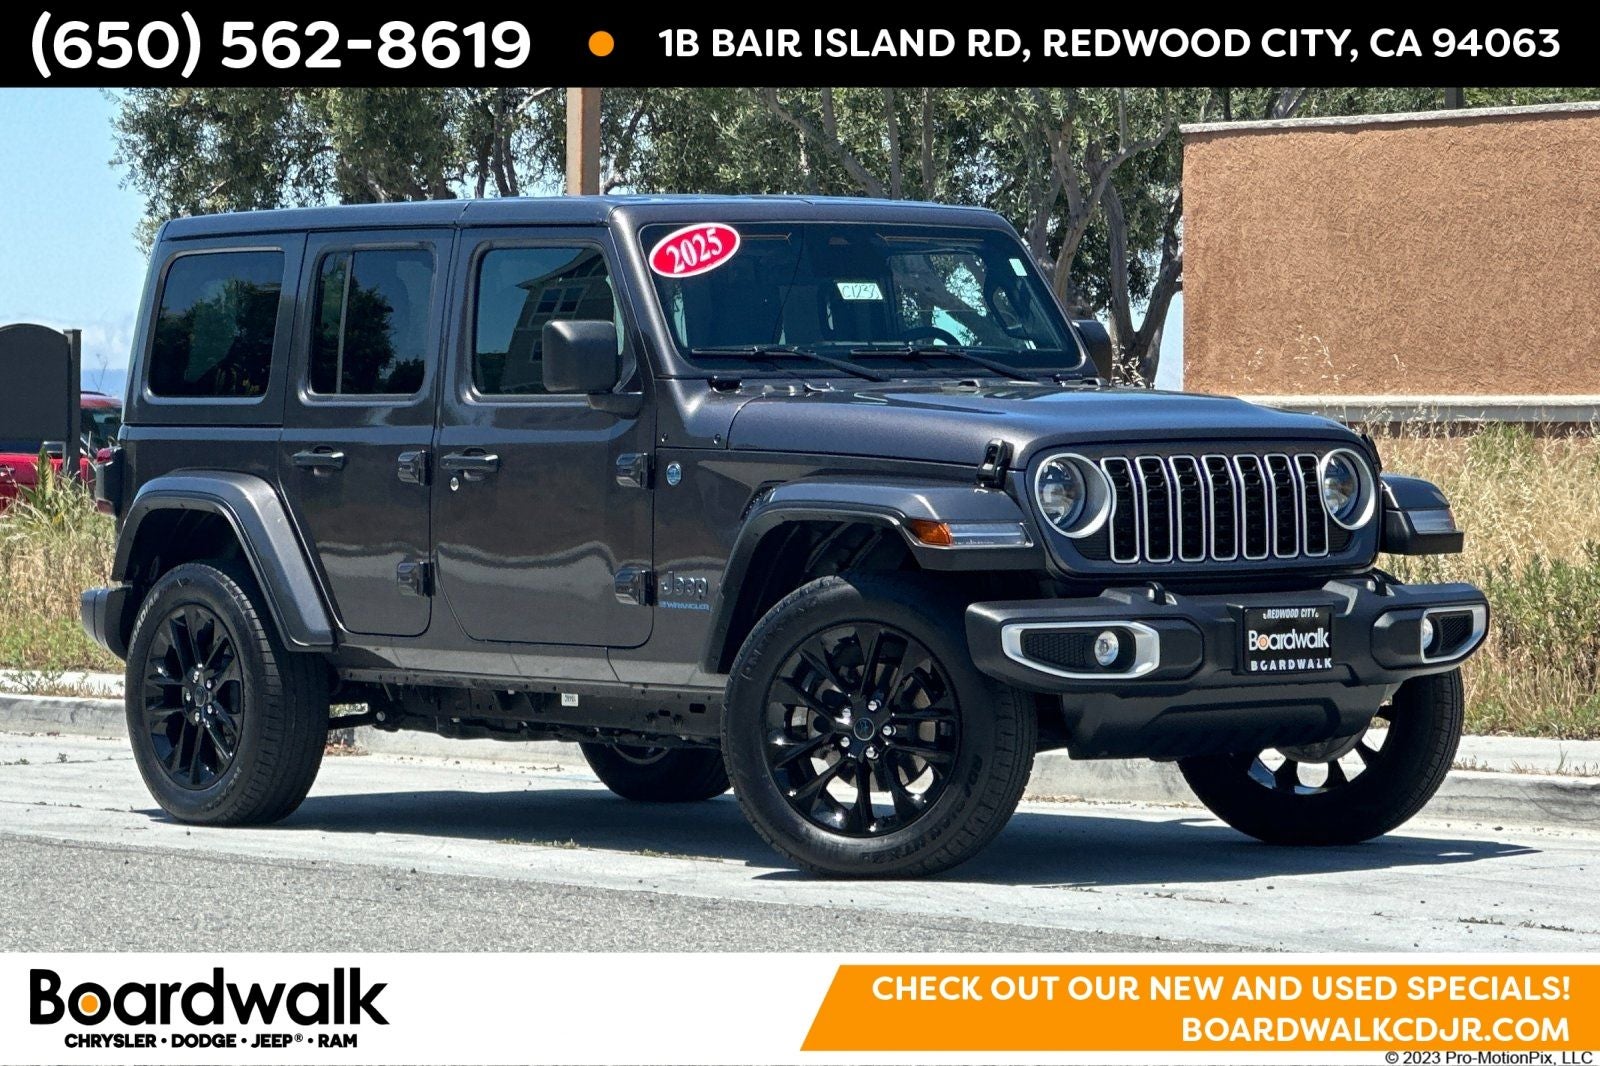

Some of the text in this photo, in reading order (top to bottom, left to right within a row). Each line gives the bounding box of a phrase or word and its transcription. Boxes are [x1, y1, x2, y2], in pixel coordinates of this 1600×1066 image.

[665, 228, 723, 274] 2025
[660, 570, 708, 600] Jeep
[1267, 607, 1316, 619] REDWOOD CITY
[1248, 627, 1330, 651] Boardwalk
[1250, 657, 1332, 671] BOARDWALK
